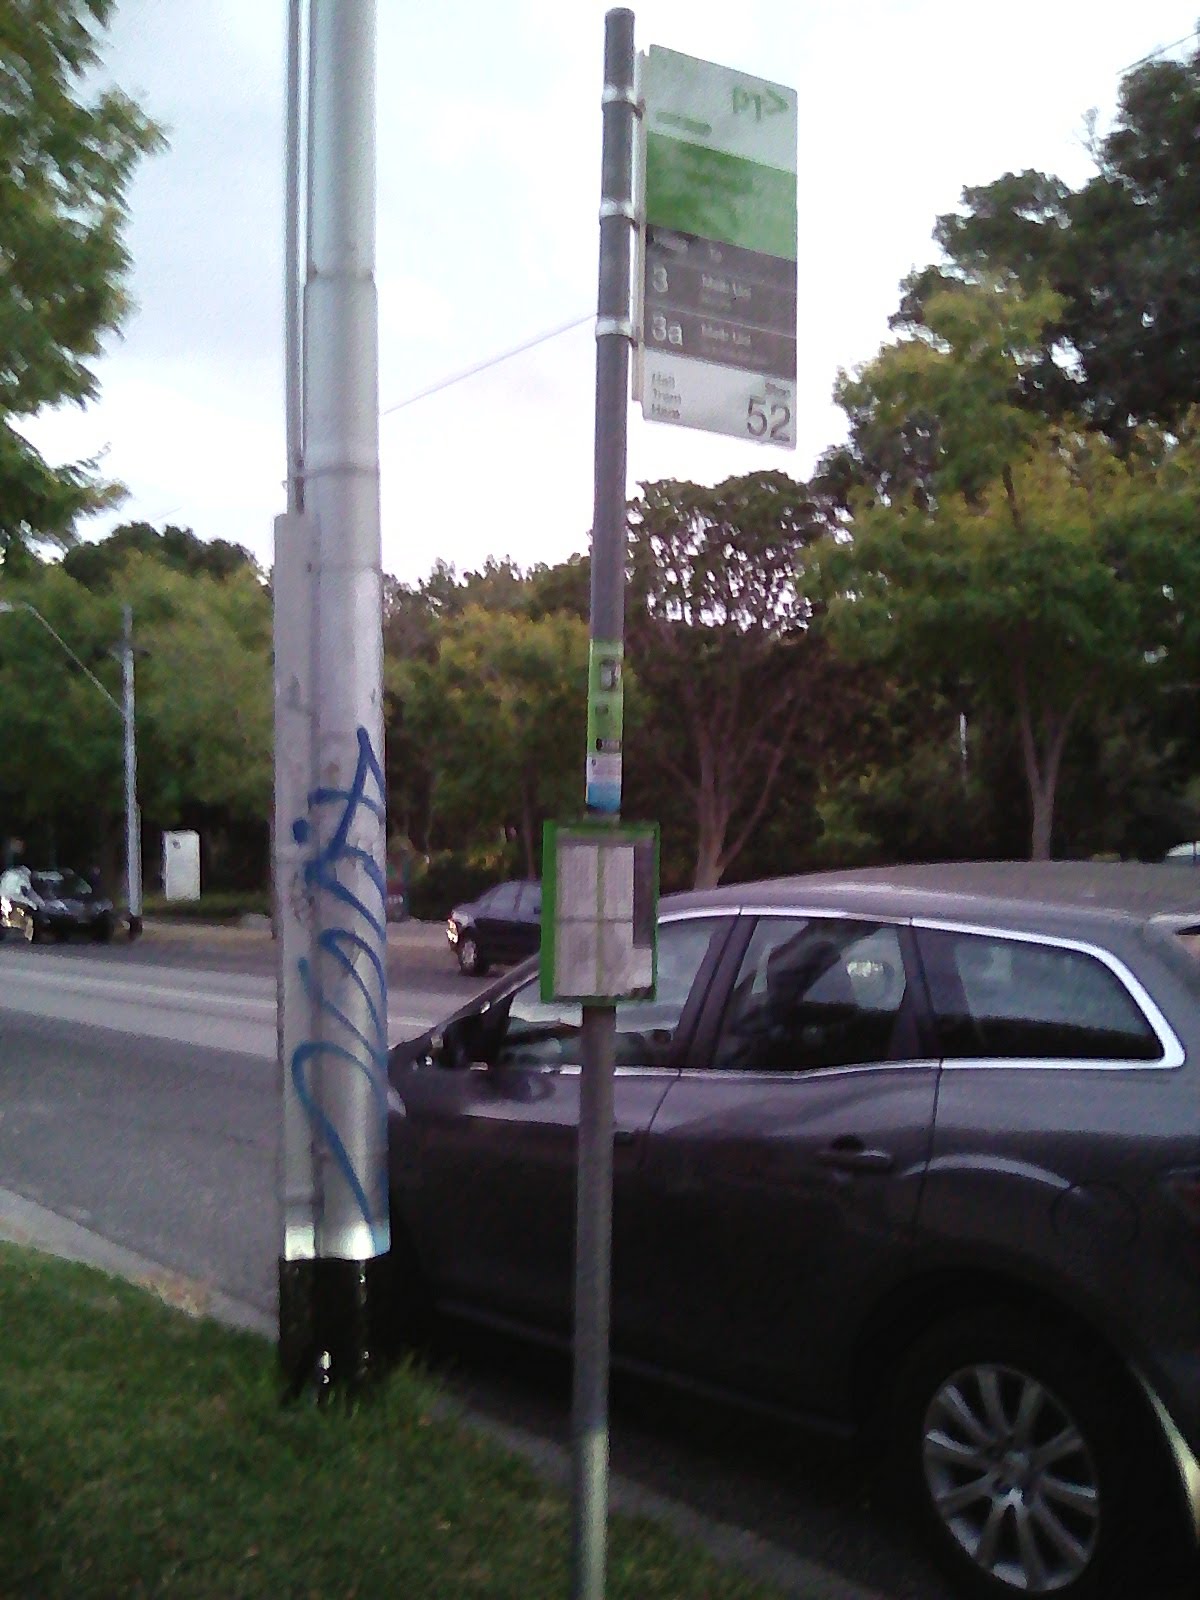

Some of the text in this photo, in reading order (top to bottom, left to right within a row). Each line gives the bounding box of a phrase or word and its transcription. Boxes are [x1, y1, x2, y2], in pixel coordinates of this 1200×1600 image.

[652, 263, 668, 293] 3
[652, 311, 683, 346] 3a
[747, 394, 791, 442] 52
